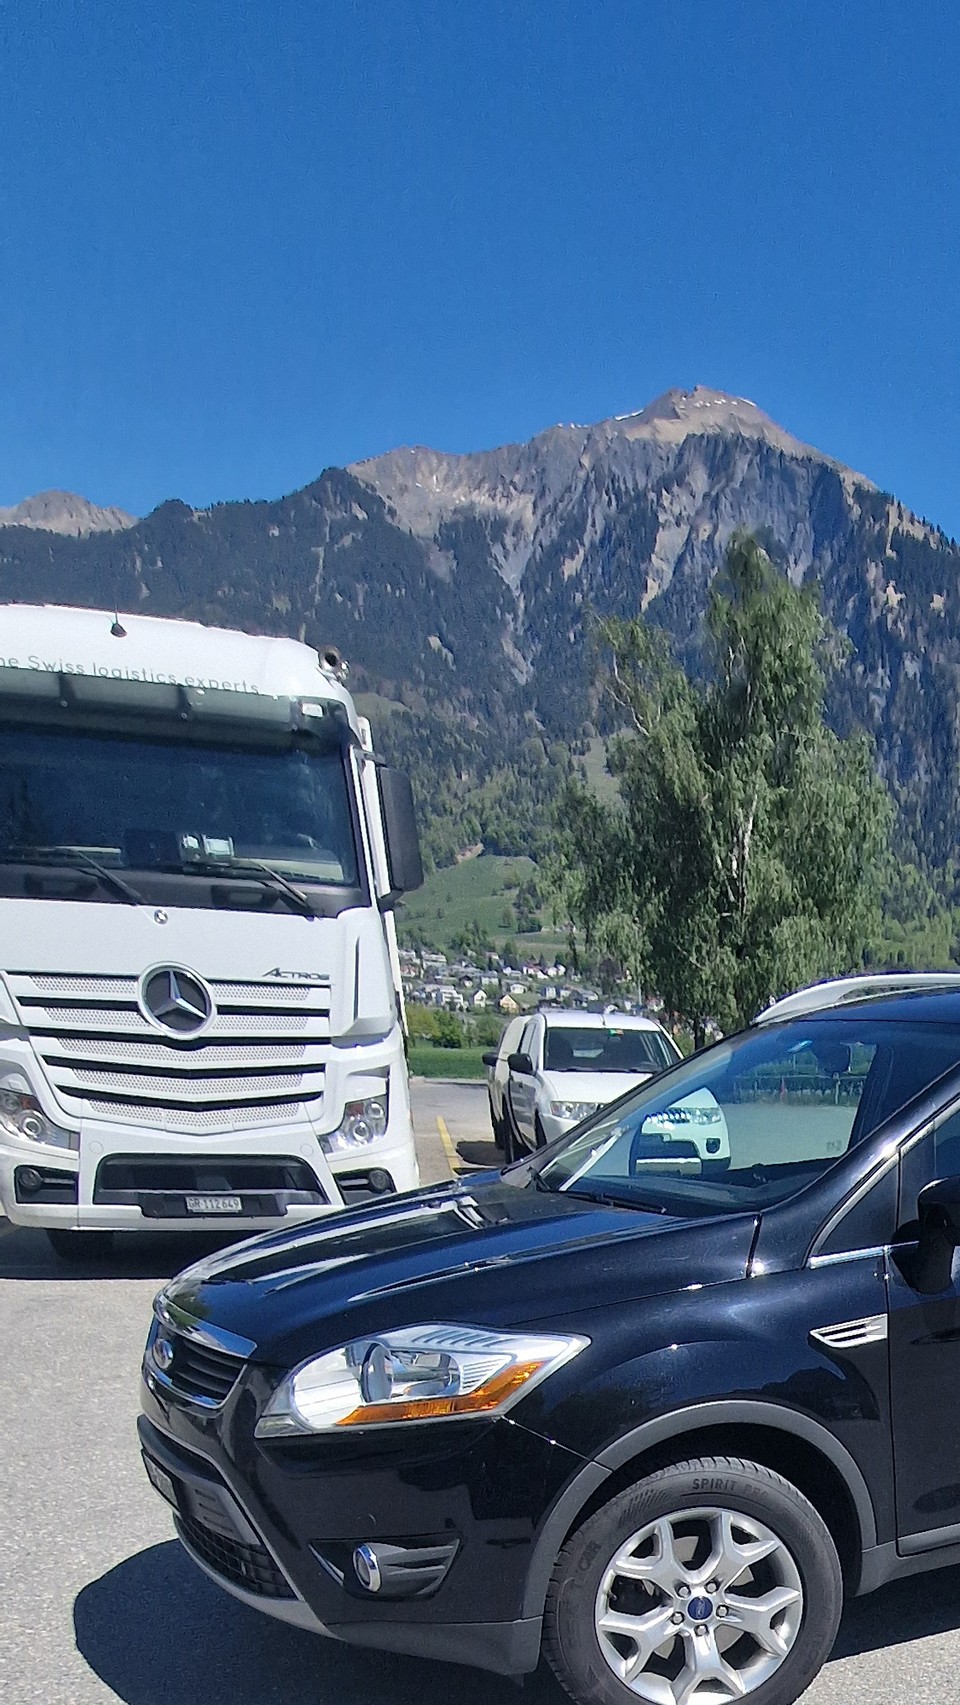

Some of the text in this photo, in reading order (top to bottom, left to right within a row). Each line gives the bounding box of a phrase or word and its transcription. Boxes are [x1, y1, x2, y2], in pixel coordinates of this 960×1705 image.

[27, 654, 86, 674] Swiss
[92, 661, 177, 684] logistics
[692, 1478, 737, 1491] SPIRIT
